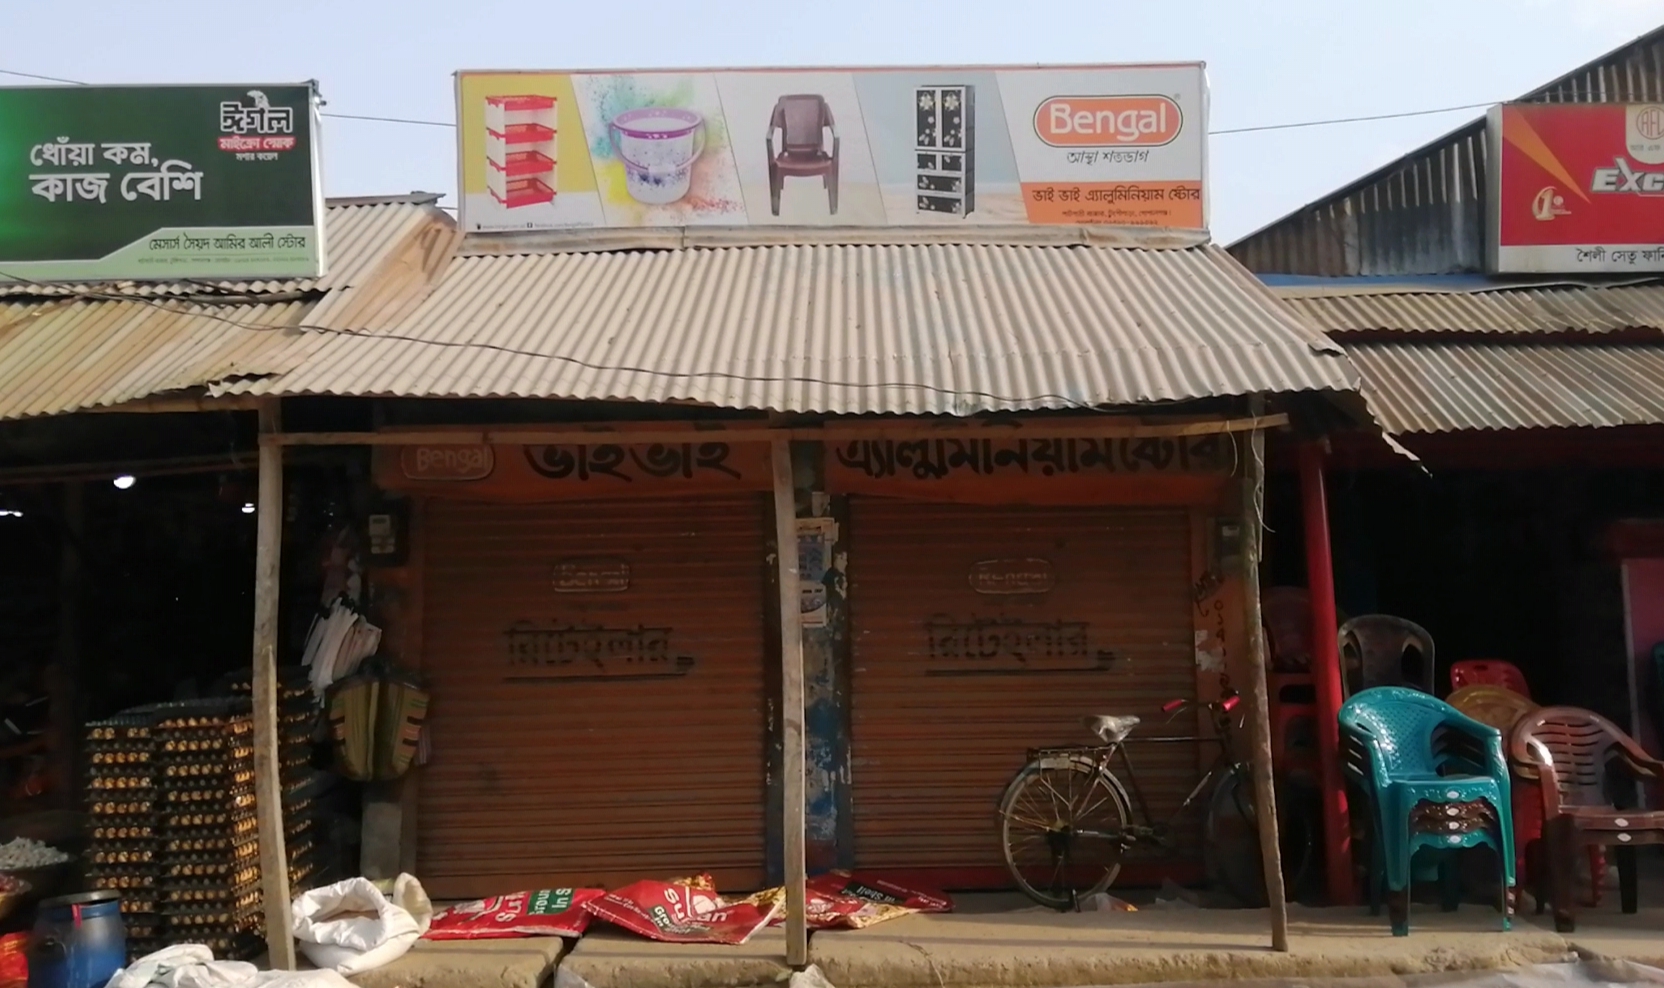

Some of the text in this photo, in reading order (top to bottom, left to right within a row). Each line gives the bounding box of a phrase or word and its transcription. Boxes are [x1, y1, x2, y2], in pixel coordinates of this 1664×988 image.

[1050, 103, 1167, 142] Bengal
[29, 136, 95, 167] ধোঁয়া
[1102, 149, 1150, 163] শতভাগ
[29, 159, 204, 204] কাজ বেশি
[1032, 186, 1055, 203] ভাই
[1058, 186, 1080, 203] ভাই
[213, 233, 246, 250] আমির
[248, 232, 274, 249] আলী
[1611, 250, 1639, 265] সেতু
[415, 445, 491, 473] Bengal
